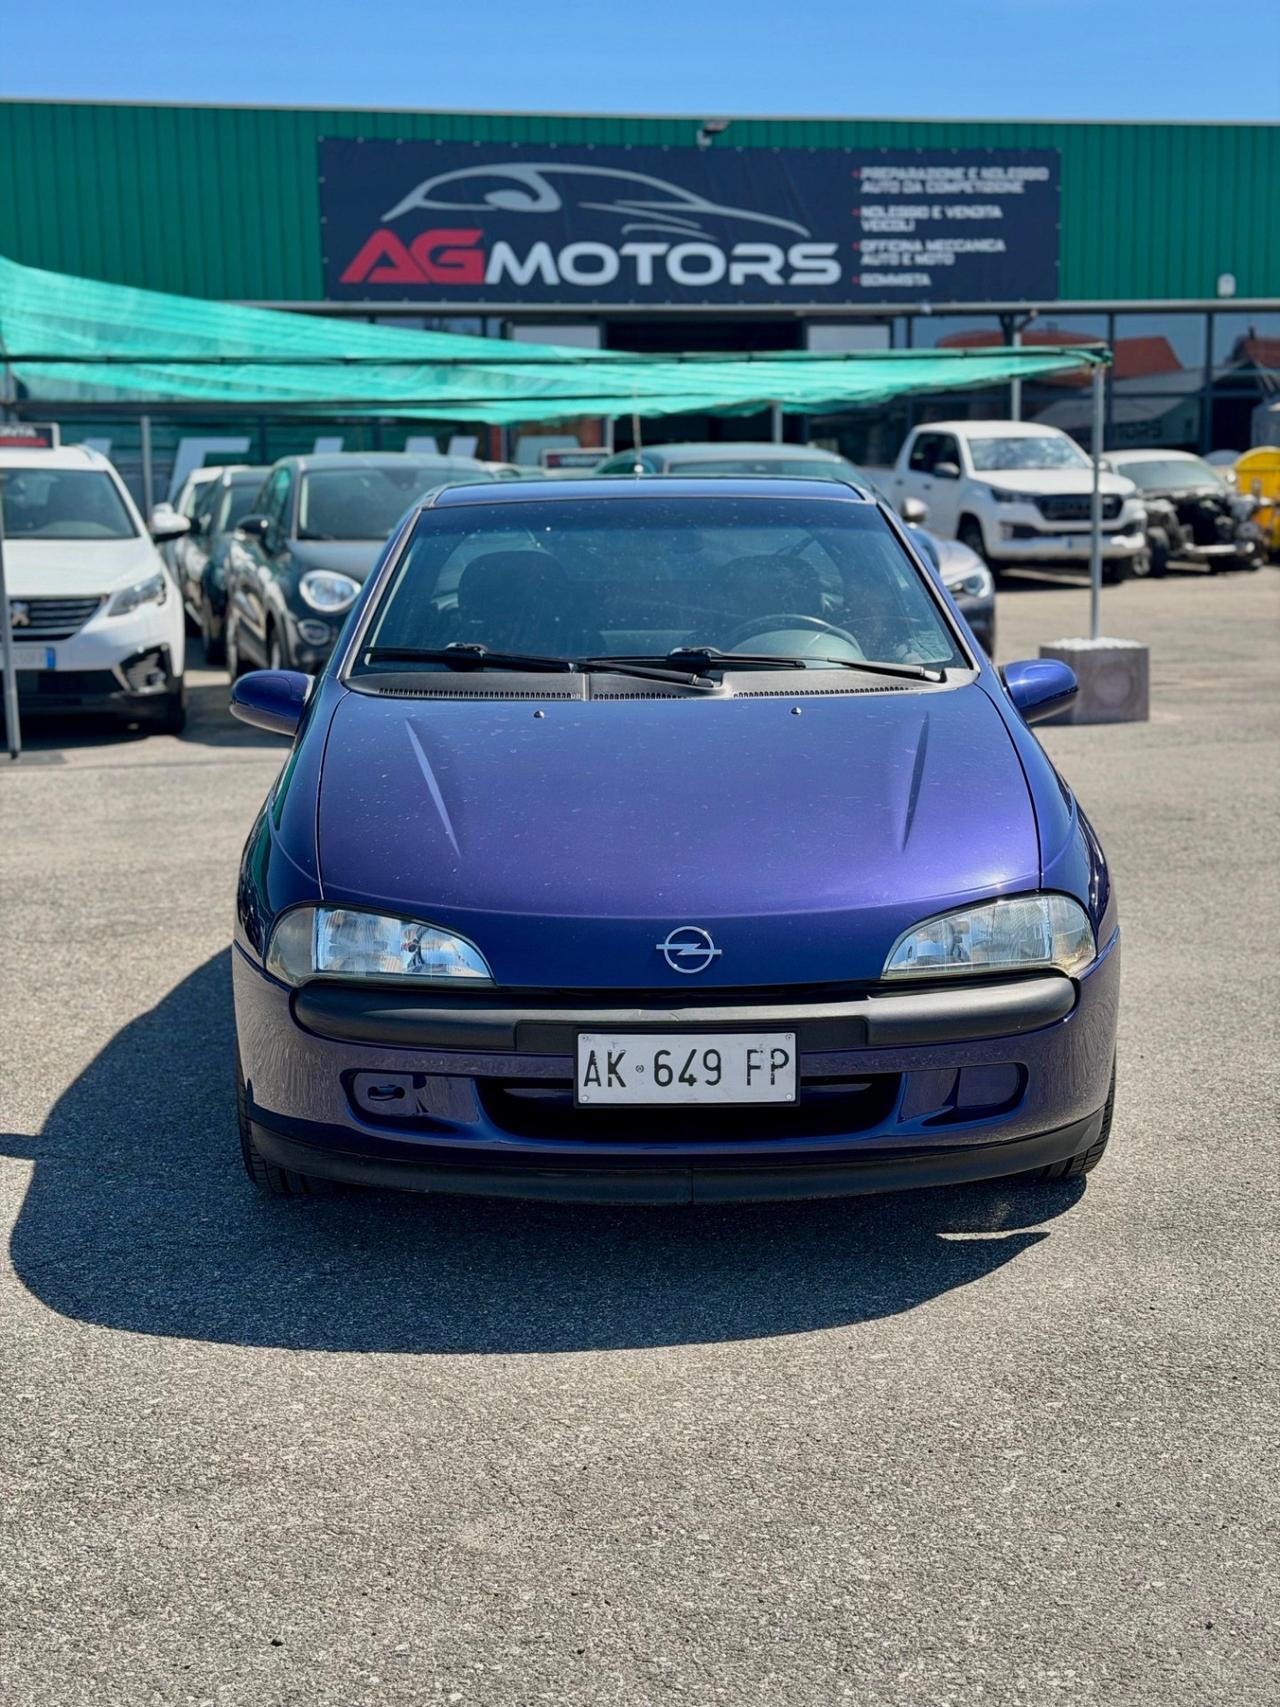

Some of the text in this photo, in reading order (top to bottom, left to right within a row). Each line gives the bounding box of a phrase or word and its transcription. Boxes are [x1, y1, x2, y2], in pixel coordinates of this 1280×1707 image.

[968, 167, 978, 180] E
[861, 181, 900, 194] AUTO
[902, 181, 923, 194] DA
[861, 205, 1002, 219] NOLEGGIO E VENDITA
[861, 239, 1006, 252] OFFICINA MECCANICA
[861, 252, 955, 266] AUTO E MOTO
[861, 273, 931, 287] GOMMISTA
[584, 1048, 789, 1087] AK 649 FP
